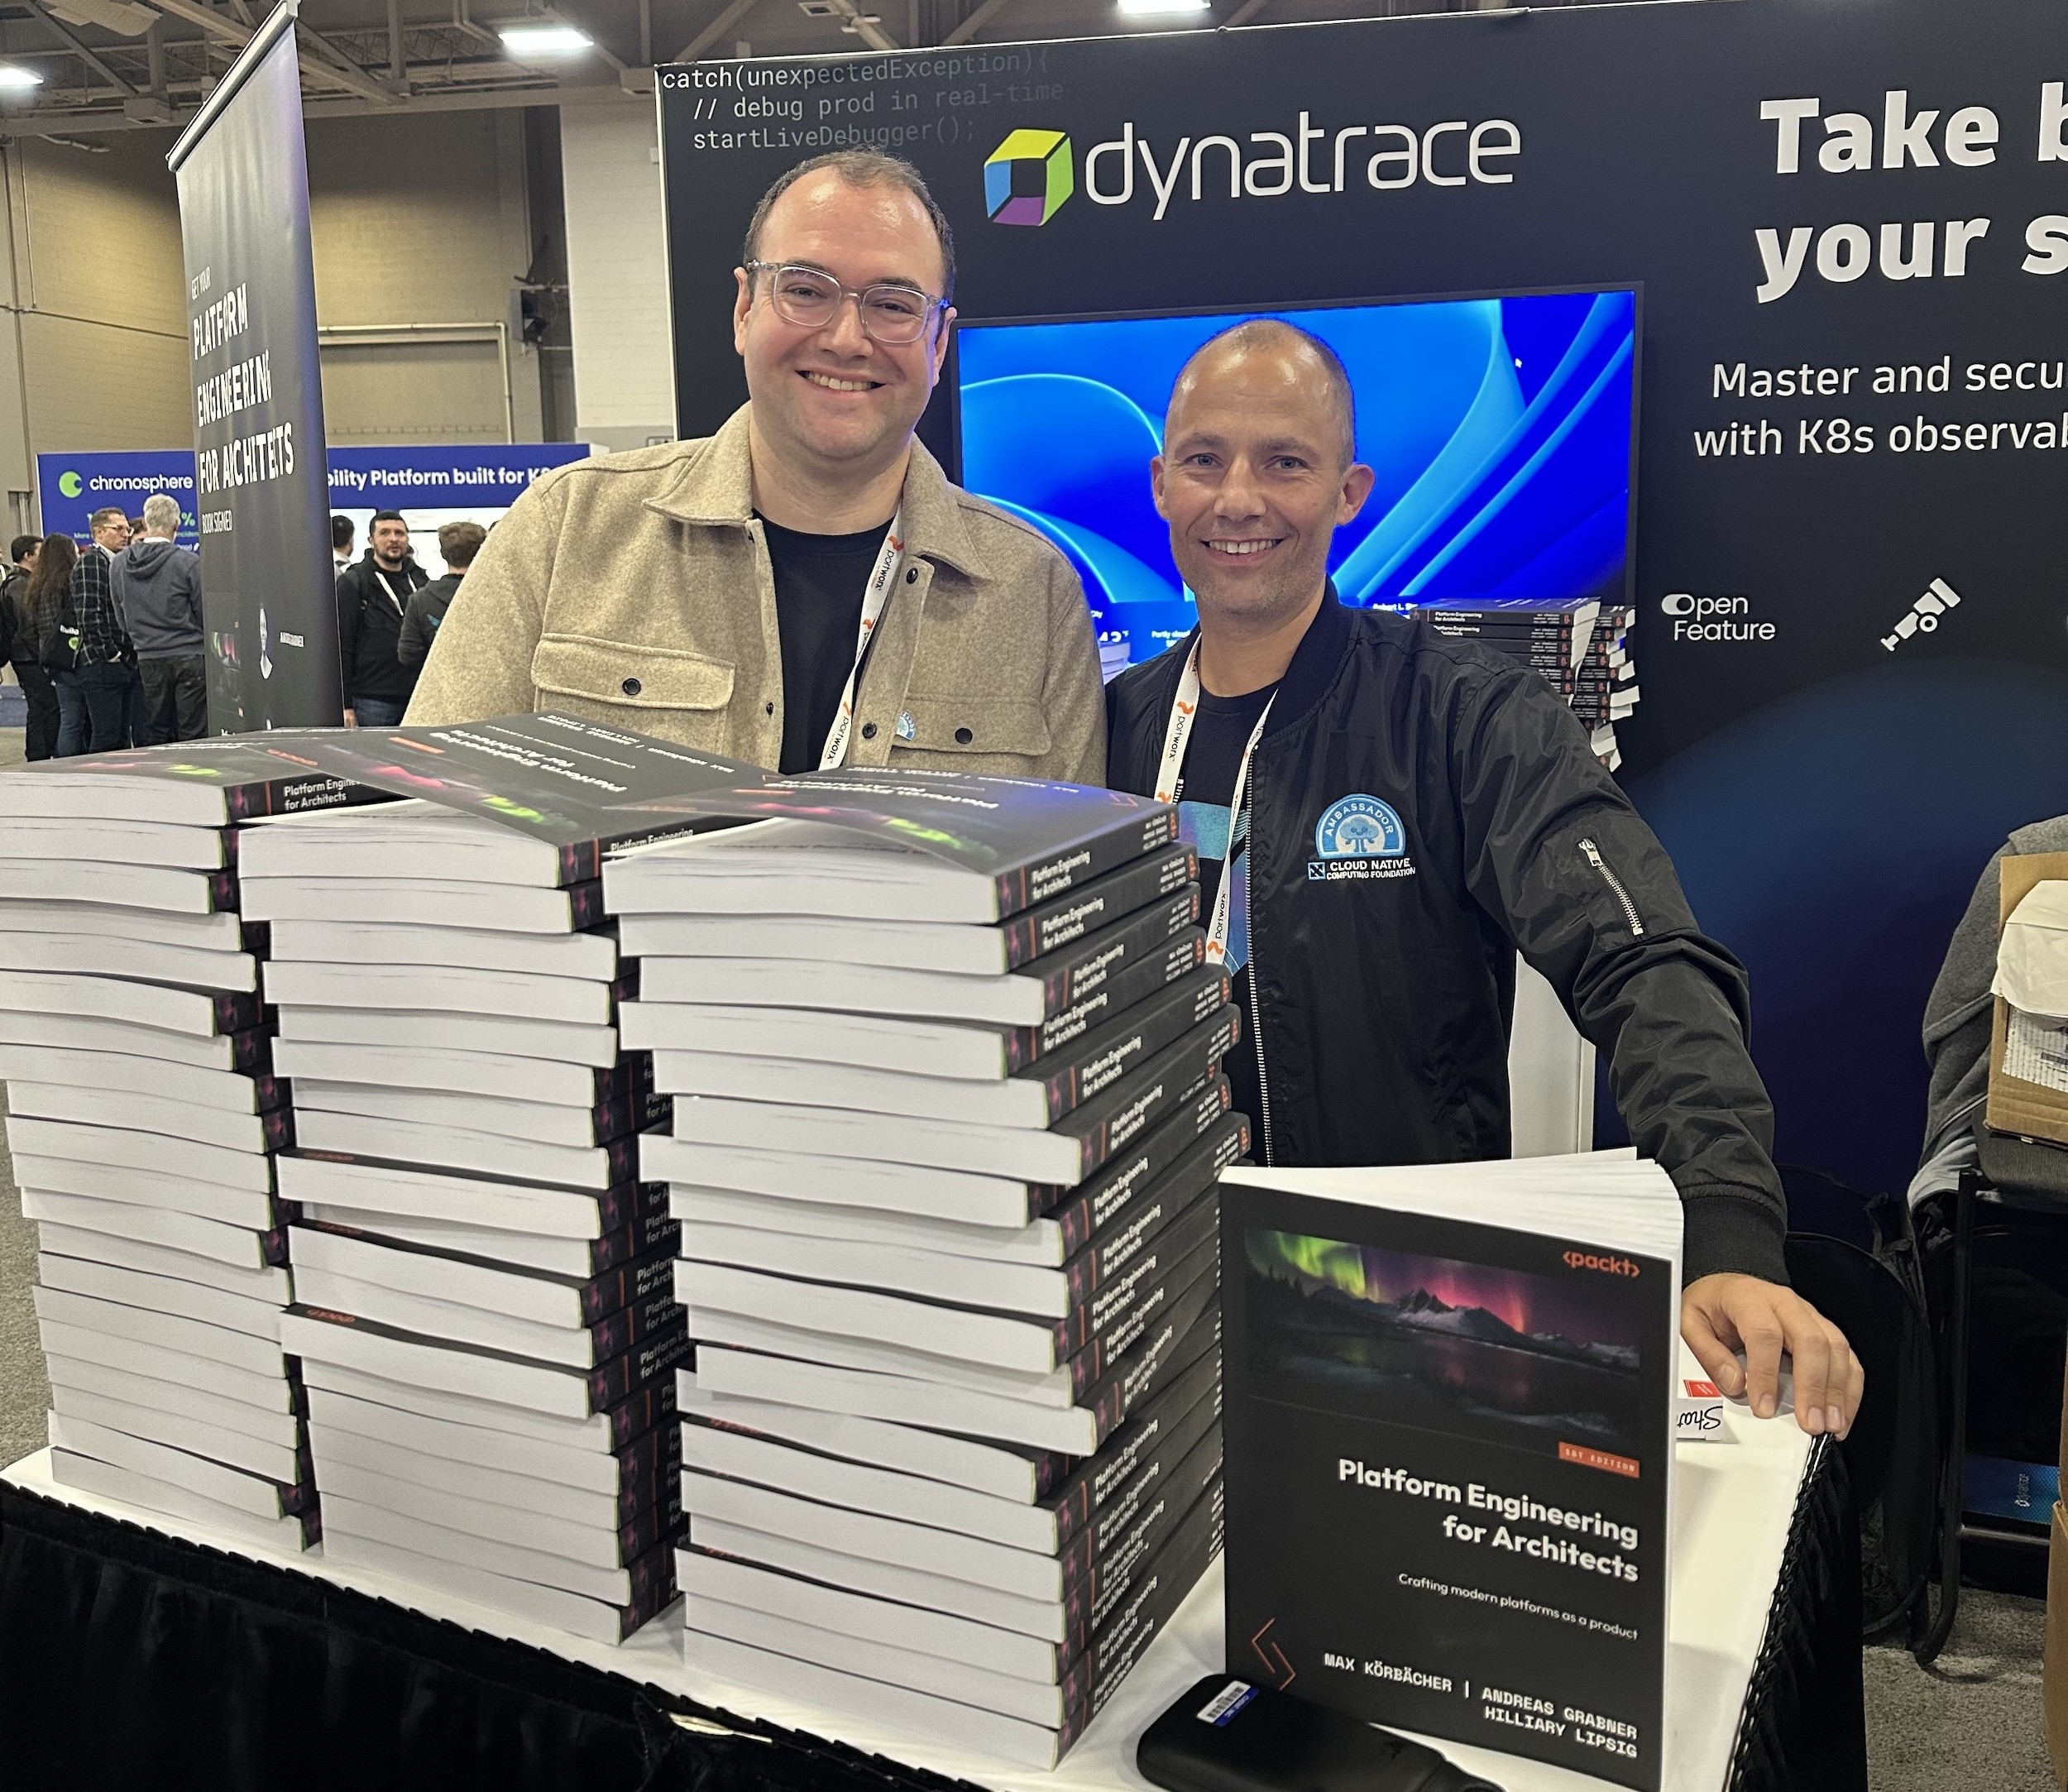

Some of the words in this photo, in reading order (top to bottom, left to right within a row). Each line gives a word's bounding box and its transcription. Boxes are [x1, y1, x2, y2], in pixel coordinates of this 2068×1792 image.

[733, 94, 803, 121] debug
[818, 96, 875, 125] prod
[892, 91, 919, 112] in
[1759, 89, 1999, 174] Take
[1085, 111, 1521, 221] dynatrace
[1755, 218, 1990, 304] your
[193, 282, 248, 361] PLATFORM
[1712, 362, 1860, 398] Master
[1872, 355, 1951, 394] and
[1965, 361, 2068, 392] secu
[1693, 419, 1783, 457] with
[1798, 417, 1874, 454] K8s
[1888, 411, 2068, 453] observa
[89, 474, 194, 494] chronosphere
[199, 448, 220, 494] FOR
[371, 469, 450, 487] Platform
[453, 467, 496, 486] built
[499, 469, 525, 486] for
[875, 549, 894, 591] portworx
[1661, 594, 1748, 621] Open
[1673, 620, 1776, 641] Feature
[827, 716, 850, 764] portworx
[1168, 715, 1186, 762] portworx
[284, 782, 325, 797] Platform
[285, 799, 299, 811] for
[300, 791, 347, 808] Architects
[1325, 803, 1394, 837] AMBASSADOR
[1326, 870, 1370, 880] COMPUTING
[1370, 867, 1416, 879] FOUNDATION
[1330, 860, 1367, 872] CLOUD
[1371, 857, 1410, 870] NATIVE
[1215, 891, 1227, 939] portworx
[645, 1295, 673, 1317] Platfo
[1590, 1454, 1636, 1473] EDITION
[1338, 1458, 1462, 1503] Platform
[1467, 1482, 1639, 1550] Engineering
[1443, 1514, 1487, 1543] for
[1492, 1526, 1640, 1582] Architects
[1398, 1573, 1448, 1596] Crafting
[1450, 1584, 1498, 1604] modern
[1500, 1595, 1560, 1619] platforms
[1561, 1611, 1577, 1623] as
[1578, 1615, 1587, 1626] a
[1589, 1617, 1639, 1641] product
[1324, 1652, 1355, 1671] MAX
[1364, 1660, 1453, 1693] KÖRBÄCHER
[1482, 1686, 1554, 1716] ANDREAS
[1563, 1706, 1638, 1740] GRABNER
[1485, 1705, 1566, 1737] HILLIARY
[1576, 1728, 1638, 1759] LIPSIG
